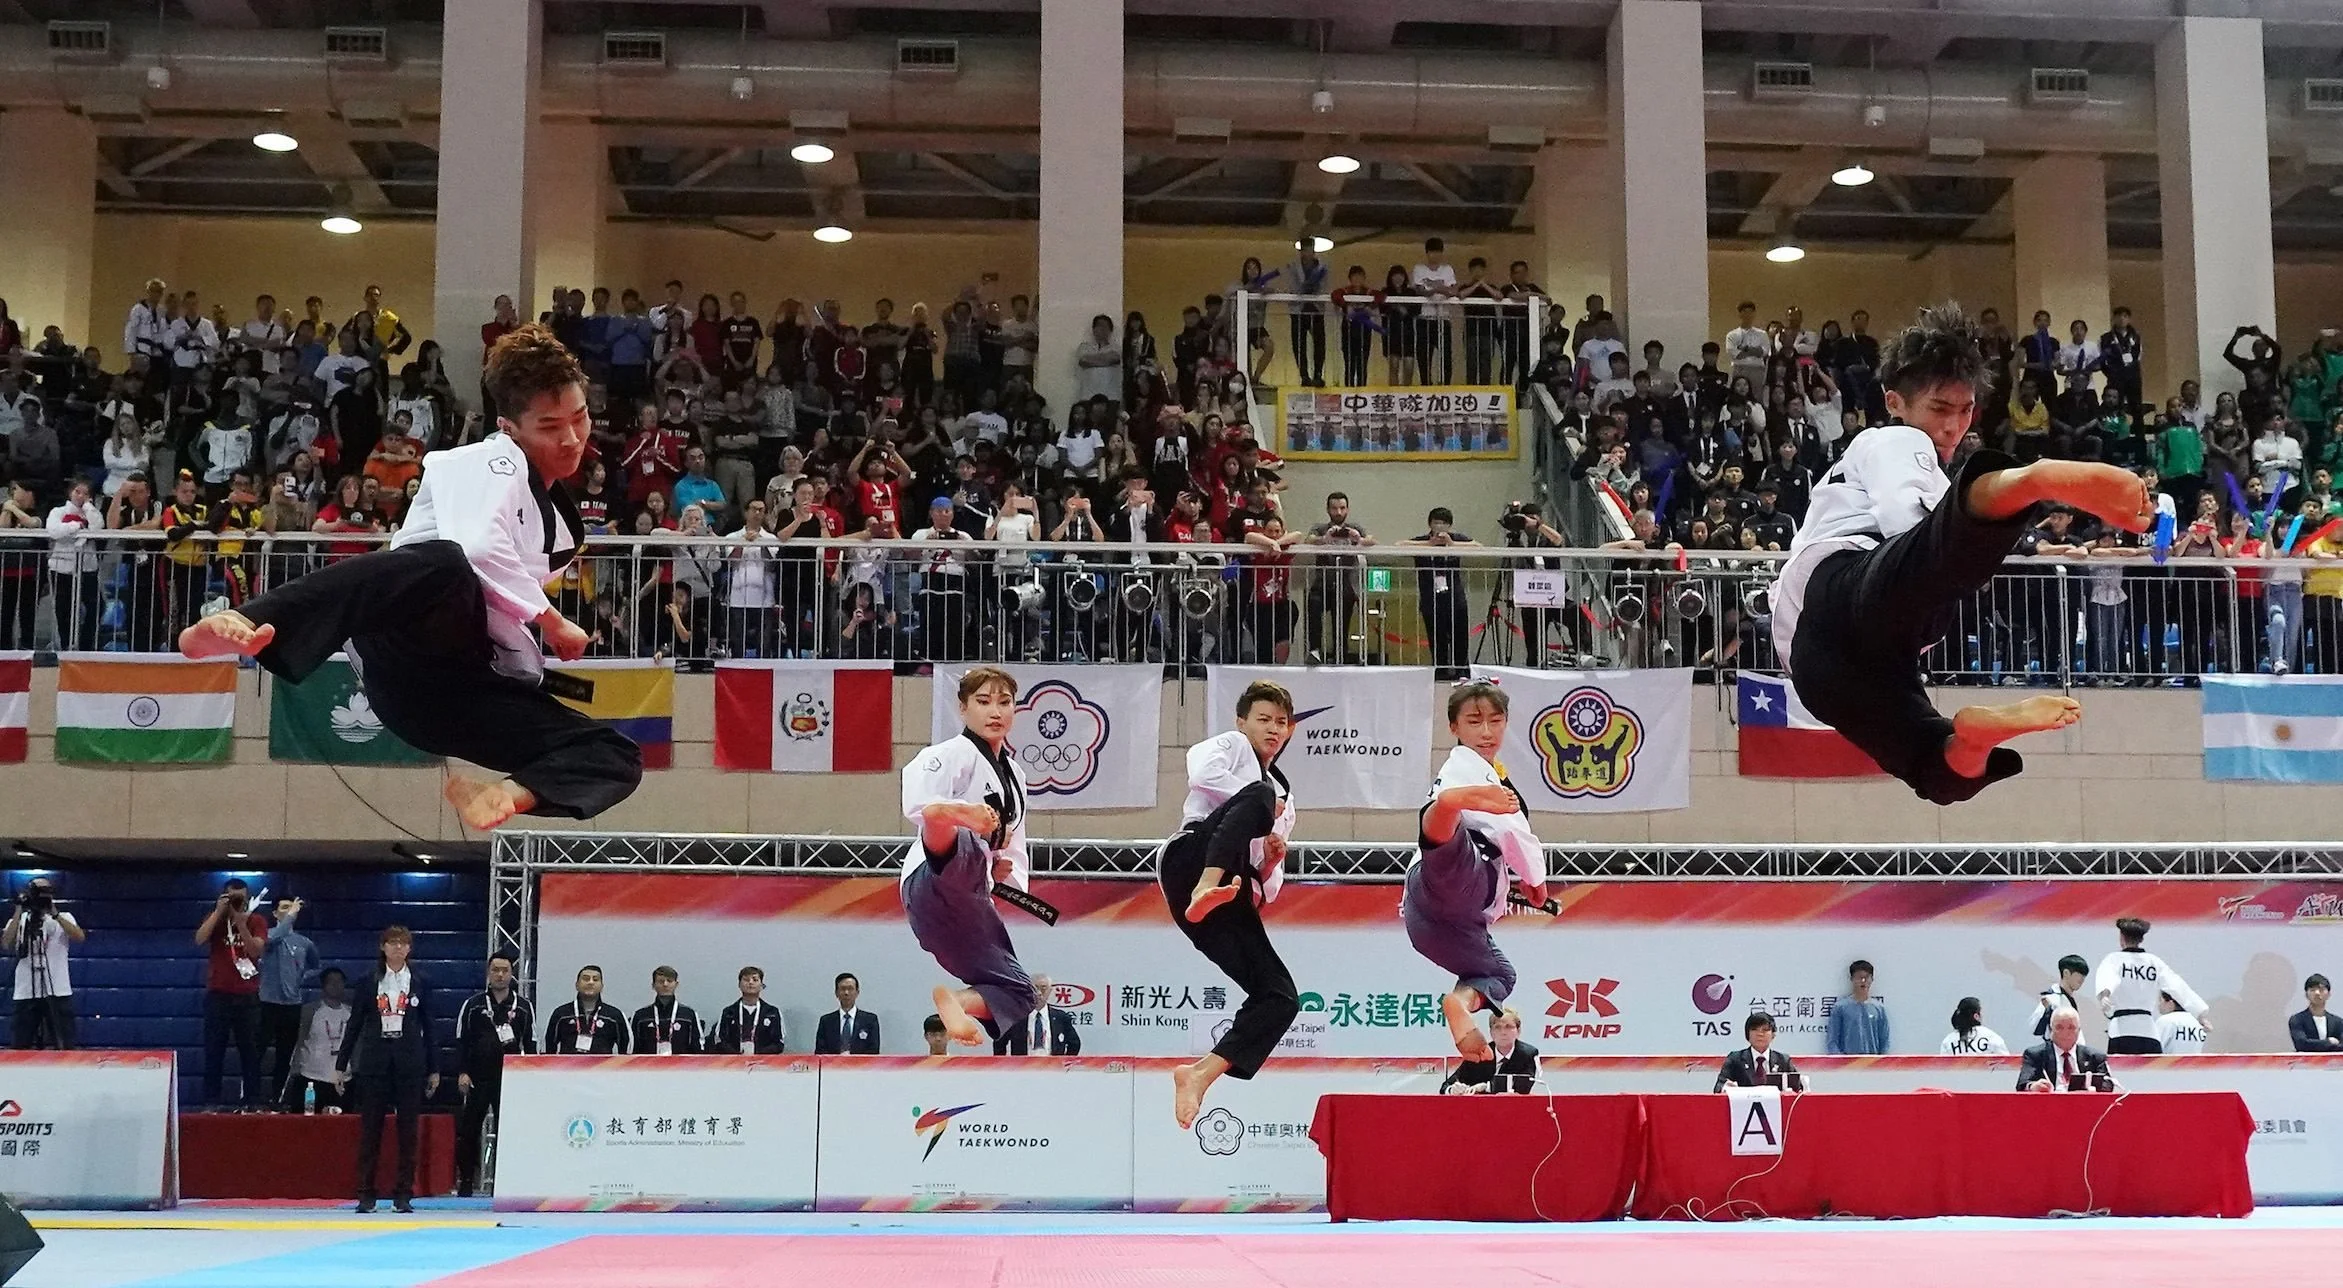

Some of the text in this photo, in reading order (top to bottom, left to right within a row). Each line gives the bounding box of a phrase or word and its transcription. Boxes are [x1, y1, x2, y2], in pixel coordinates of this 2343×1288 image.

[1306, 728, 1359, 740] WORLD
[1306, 744, 1402, 756] TAEKWONDO
[2121, 963, 2157, 981] HKG
[1121, 984, 1227, 1010] 新光人壽
[1121, 1014, 1189, 1031] Shin Kong
[1300, 1023, 1326, 1034] Taipei
[1692, 1021, 1731, 1036] TAS
[1543, 1024, 1622, 1039] KPNP
[2175, 1026, 2207, 1042] HKG
[1951, 1036, 1989, 1055] HKG
[605, 1115, 743, 1136] 教育部體育署
[959, 1124, 1009, 1133] WORLD
[1738, 1101, 1777, 1147] A
[959, 1138, 1050, 1148] TAEKWONDO
